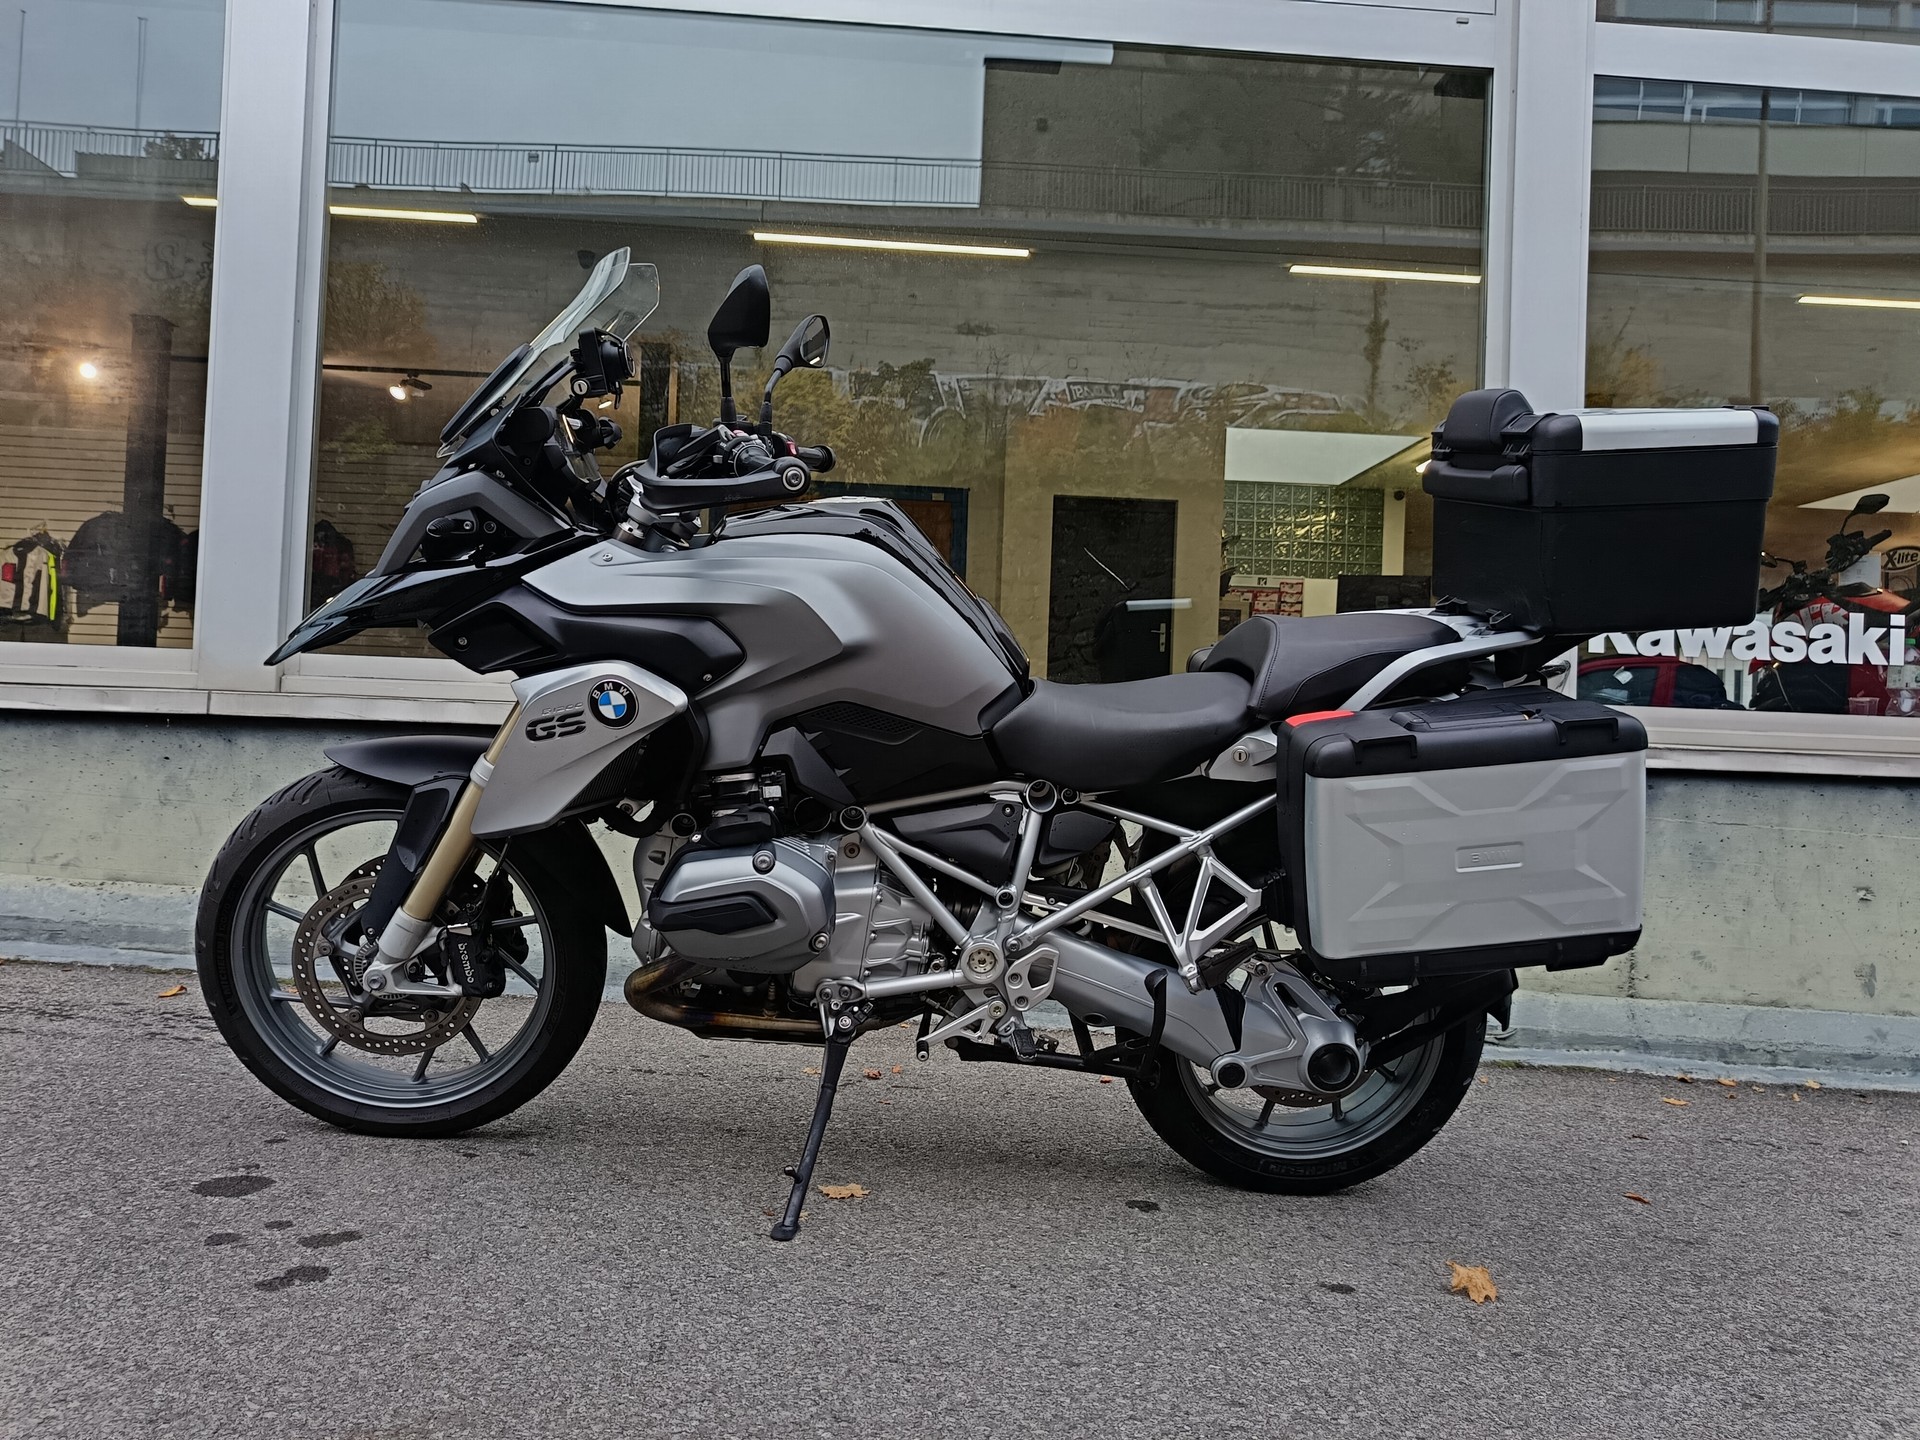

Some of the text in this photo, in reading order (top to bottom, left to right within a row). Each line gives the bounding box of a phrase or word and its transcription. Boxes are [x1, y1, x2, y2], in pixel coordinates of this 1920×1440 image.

[1884, 549, 1919, 569] X-lite
[592, 683, 630, 699] BMW
[526, 711, 586, 741] GS
[458, 942, 475, 983] brembo
[1269, 1160, 1348, 1176] MICHELIN
